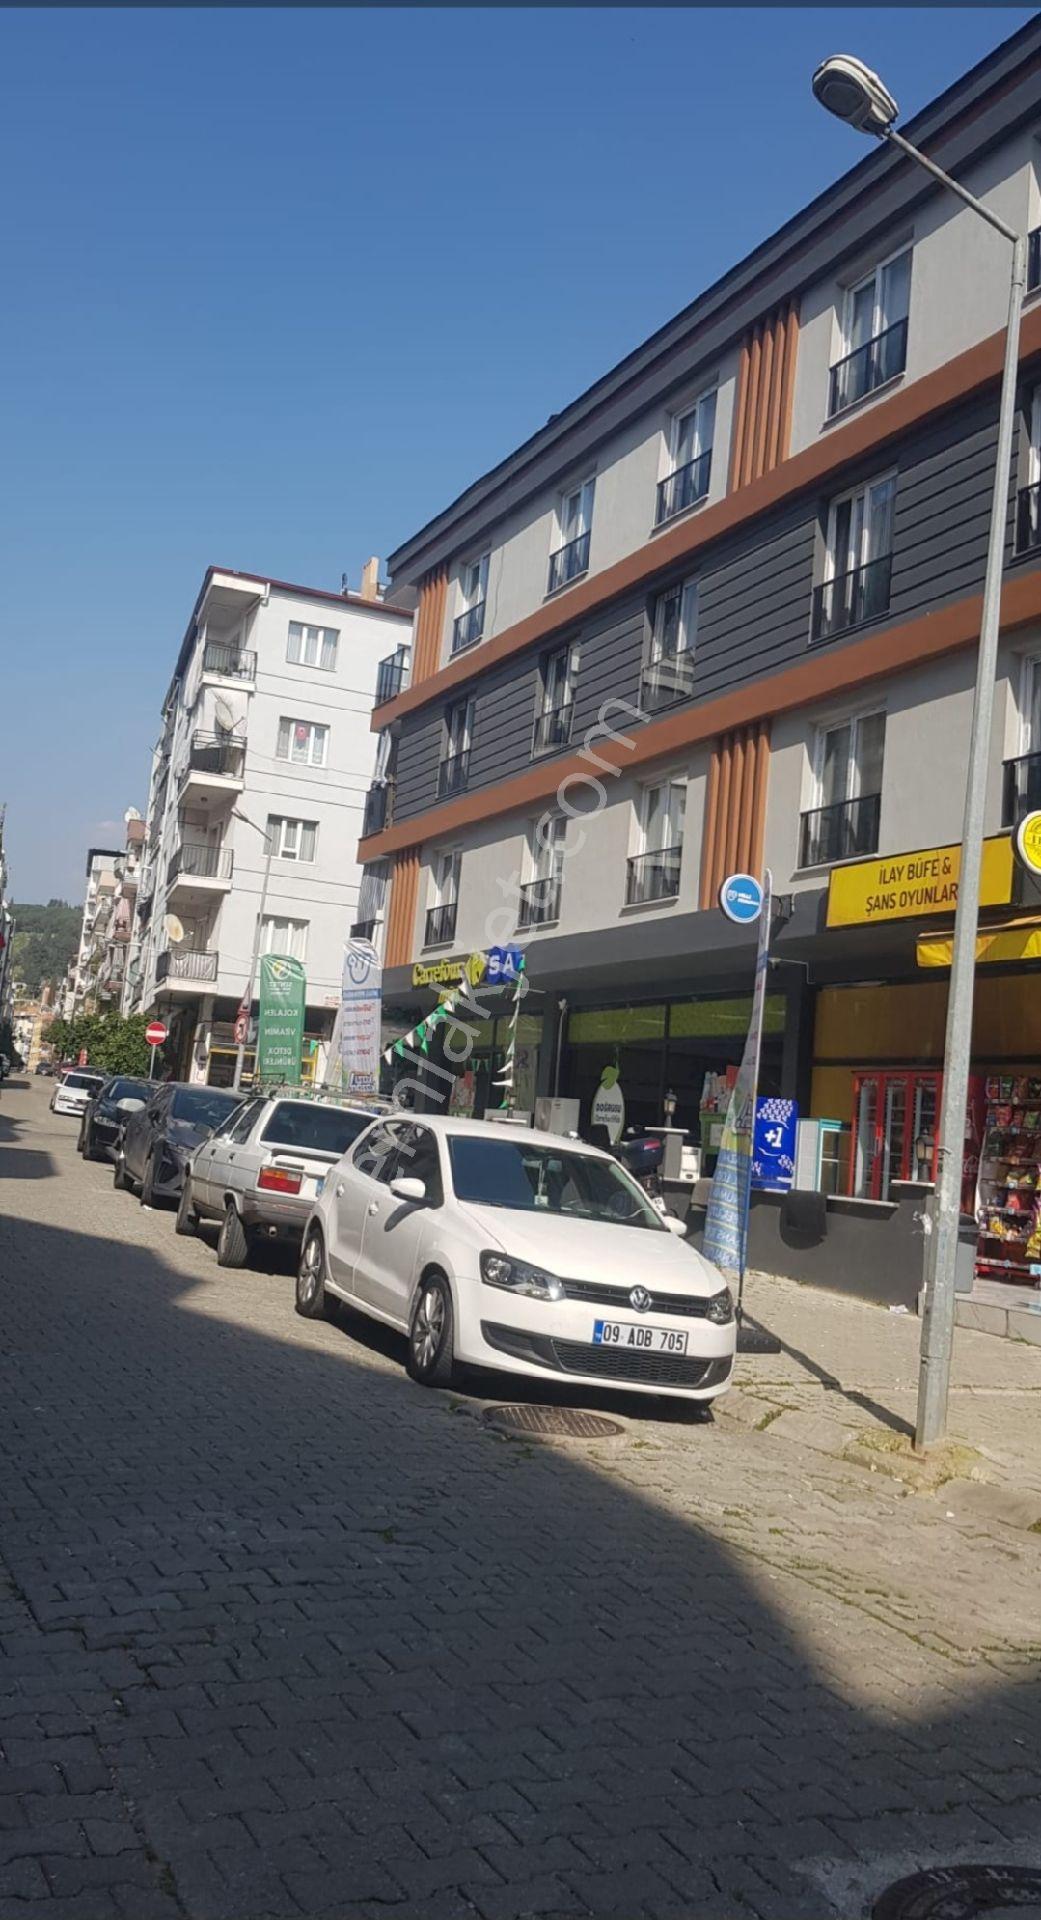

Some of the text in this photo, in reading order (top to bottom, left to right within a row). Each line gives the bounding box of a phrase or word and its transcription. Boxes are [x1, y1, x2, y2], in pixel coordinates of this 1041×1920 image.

[878, 857, 951, 885] İLAY BÜFE &
[865, 883, 959, 917] ŞANS OYUNLAR
[412, 953, 514, 986] Carrefour SA
[765, 1127, 783, 1148] +1
[603, 1325, 620, 1343] 09
[627, 1327, 653, 1347] ADB
[660, 1332, 684, 1351] 705
